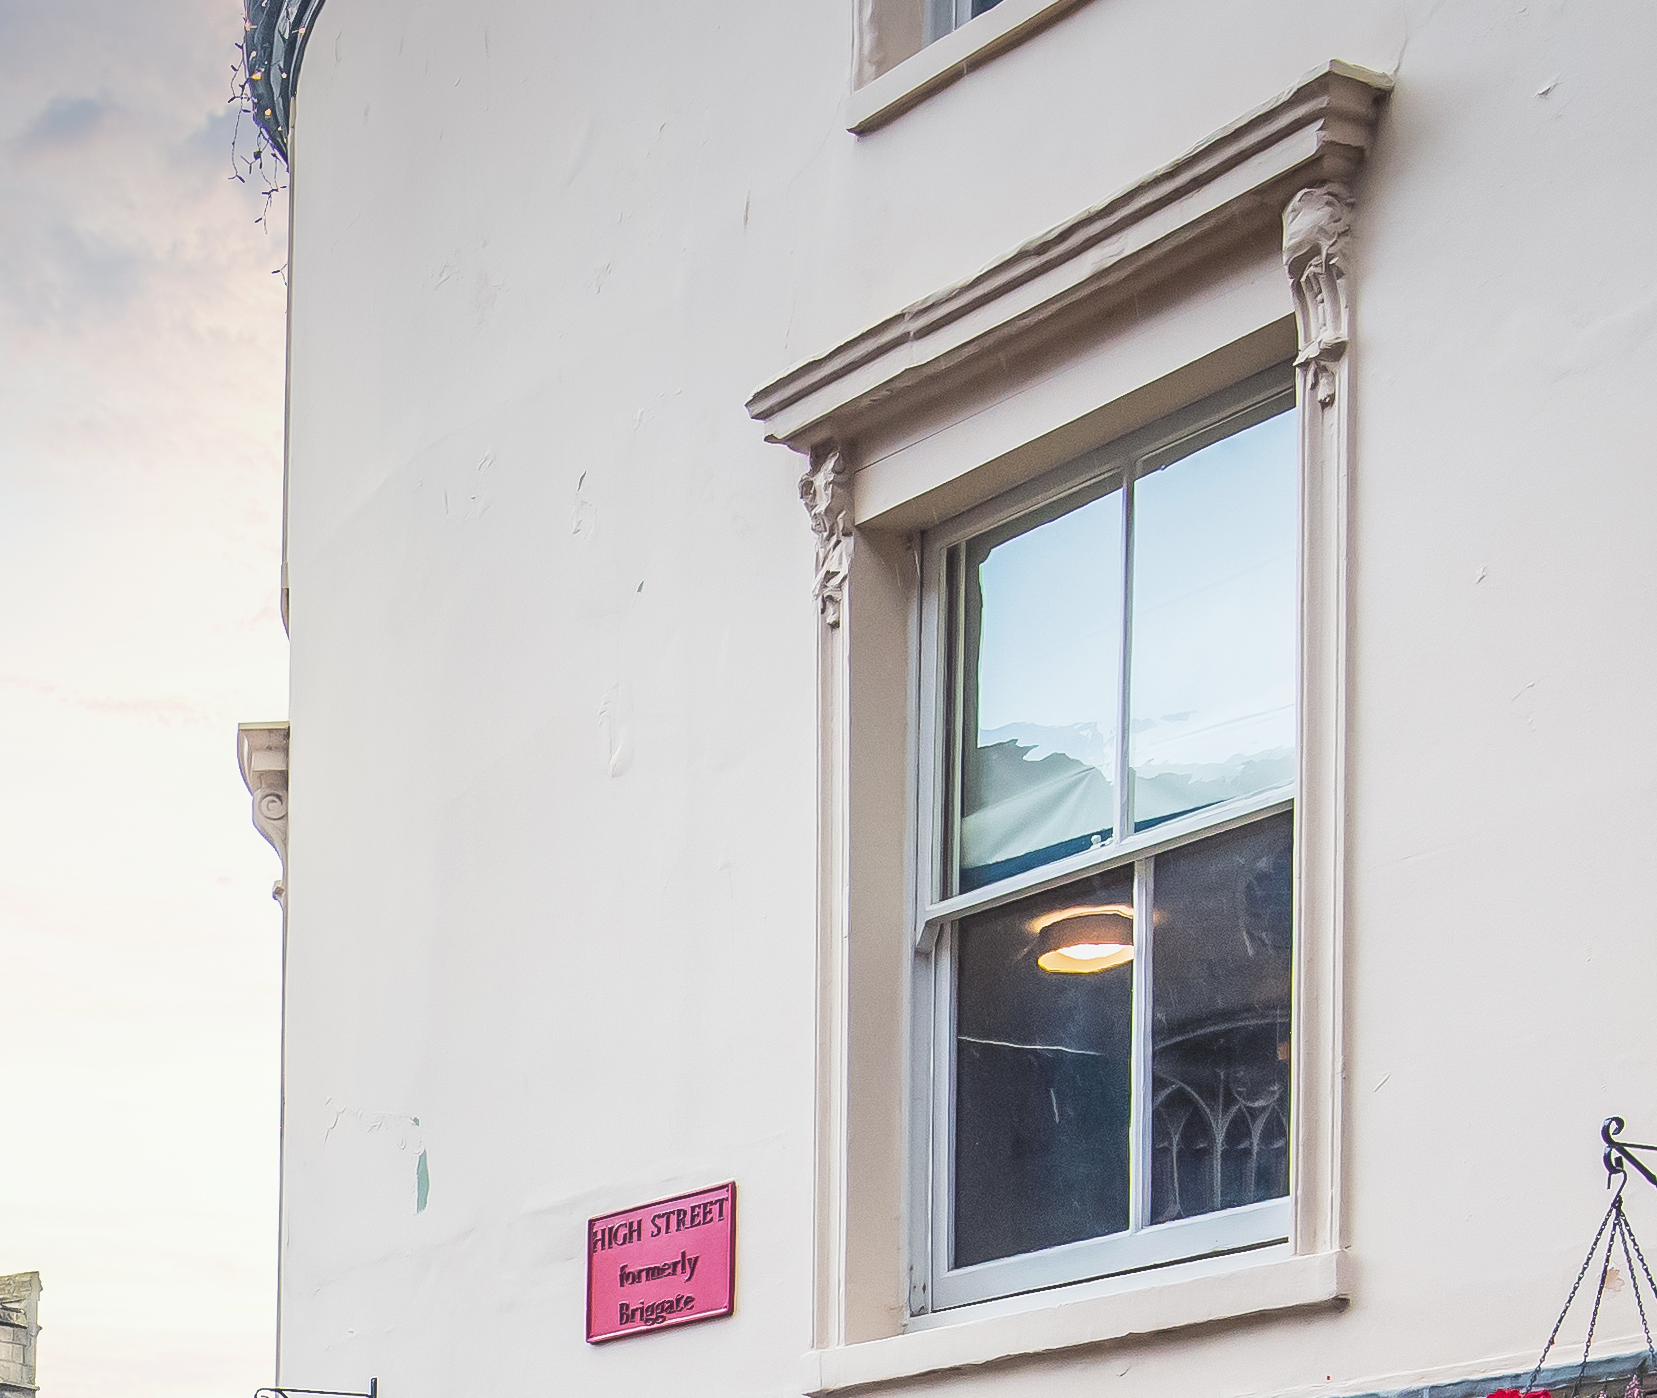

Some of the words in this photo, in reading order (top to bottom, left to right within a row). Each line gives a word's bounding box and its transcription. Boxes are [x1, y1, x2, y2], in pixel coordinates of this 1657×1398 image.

[592, 1218, 642, 1253] HIGH
[650, 1197, 729, 1238] STREET
[619, 1249, 700, 1287] formerly
[619, 1293, 696, 1326] Briggate
